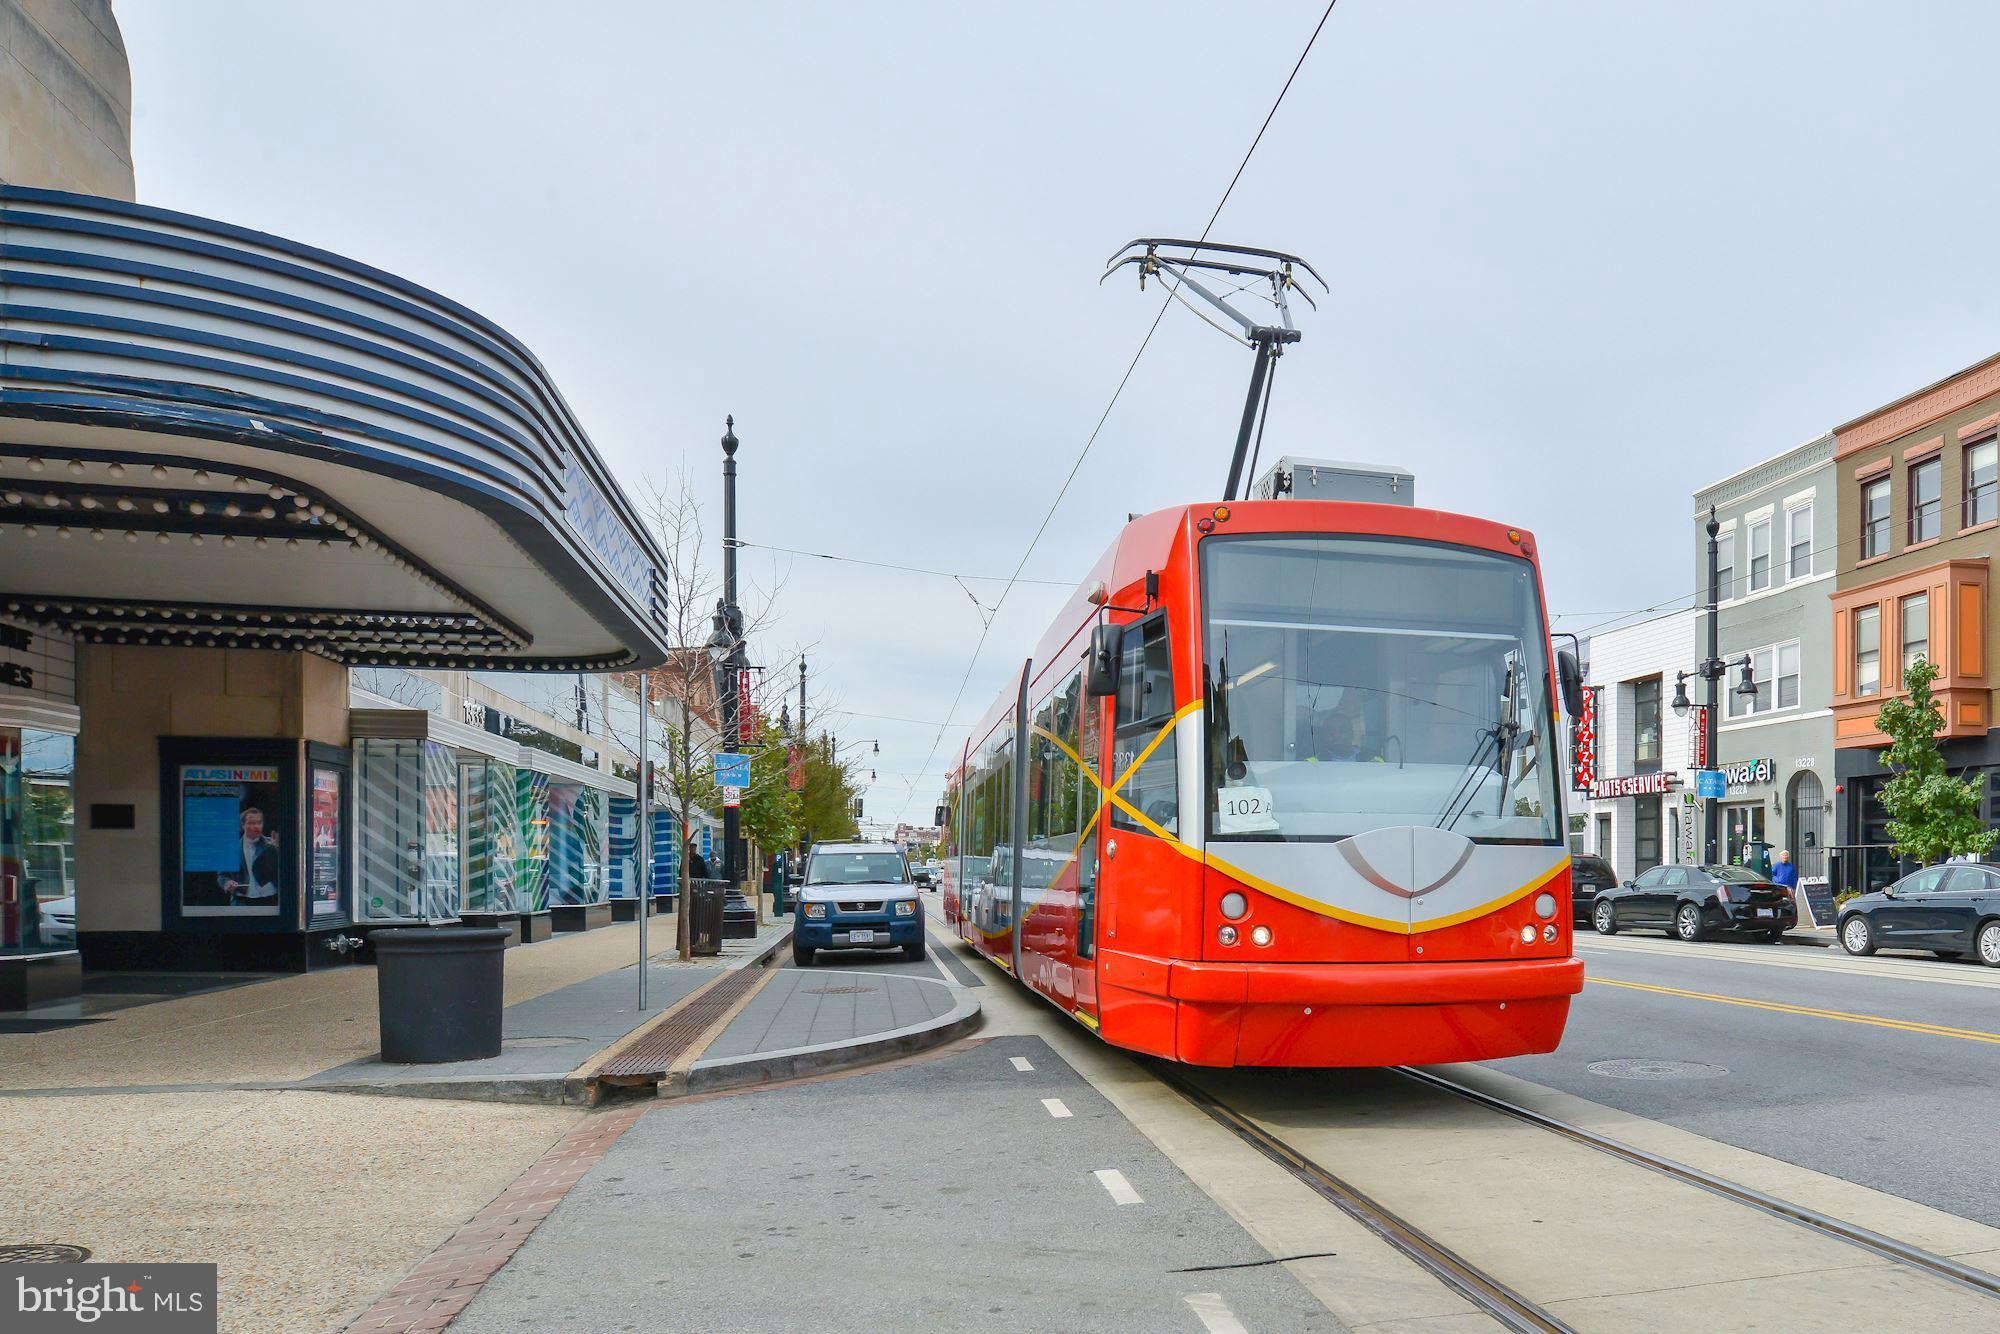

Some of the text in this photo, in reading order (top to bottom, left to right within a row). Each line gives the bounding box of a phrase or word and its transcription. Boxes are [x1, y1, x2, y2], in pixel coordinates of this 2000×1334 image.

[1795, 758, 1815, 768] 1322B
[1718, 759, 1771, 784] wafel
[1594, 775, 1667, 798] PARTS & SERVICE
[1729, 785, 1748, 796] 1322A
[1227, 799, 1261, 816] 102
[1763, 850, 1769, 859] P
